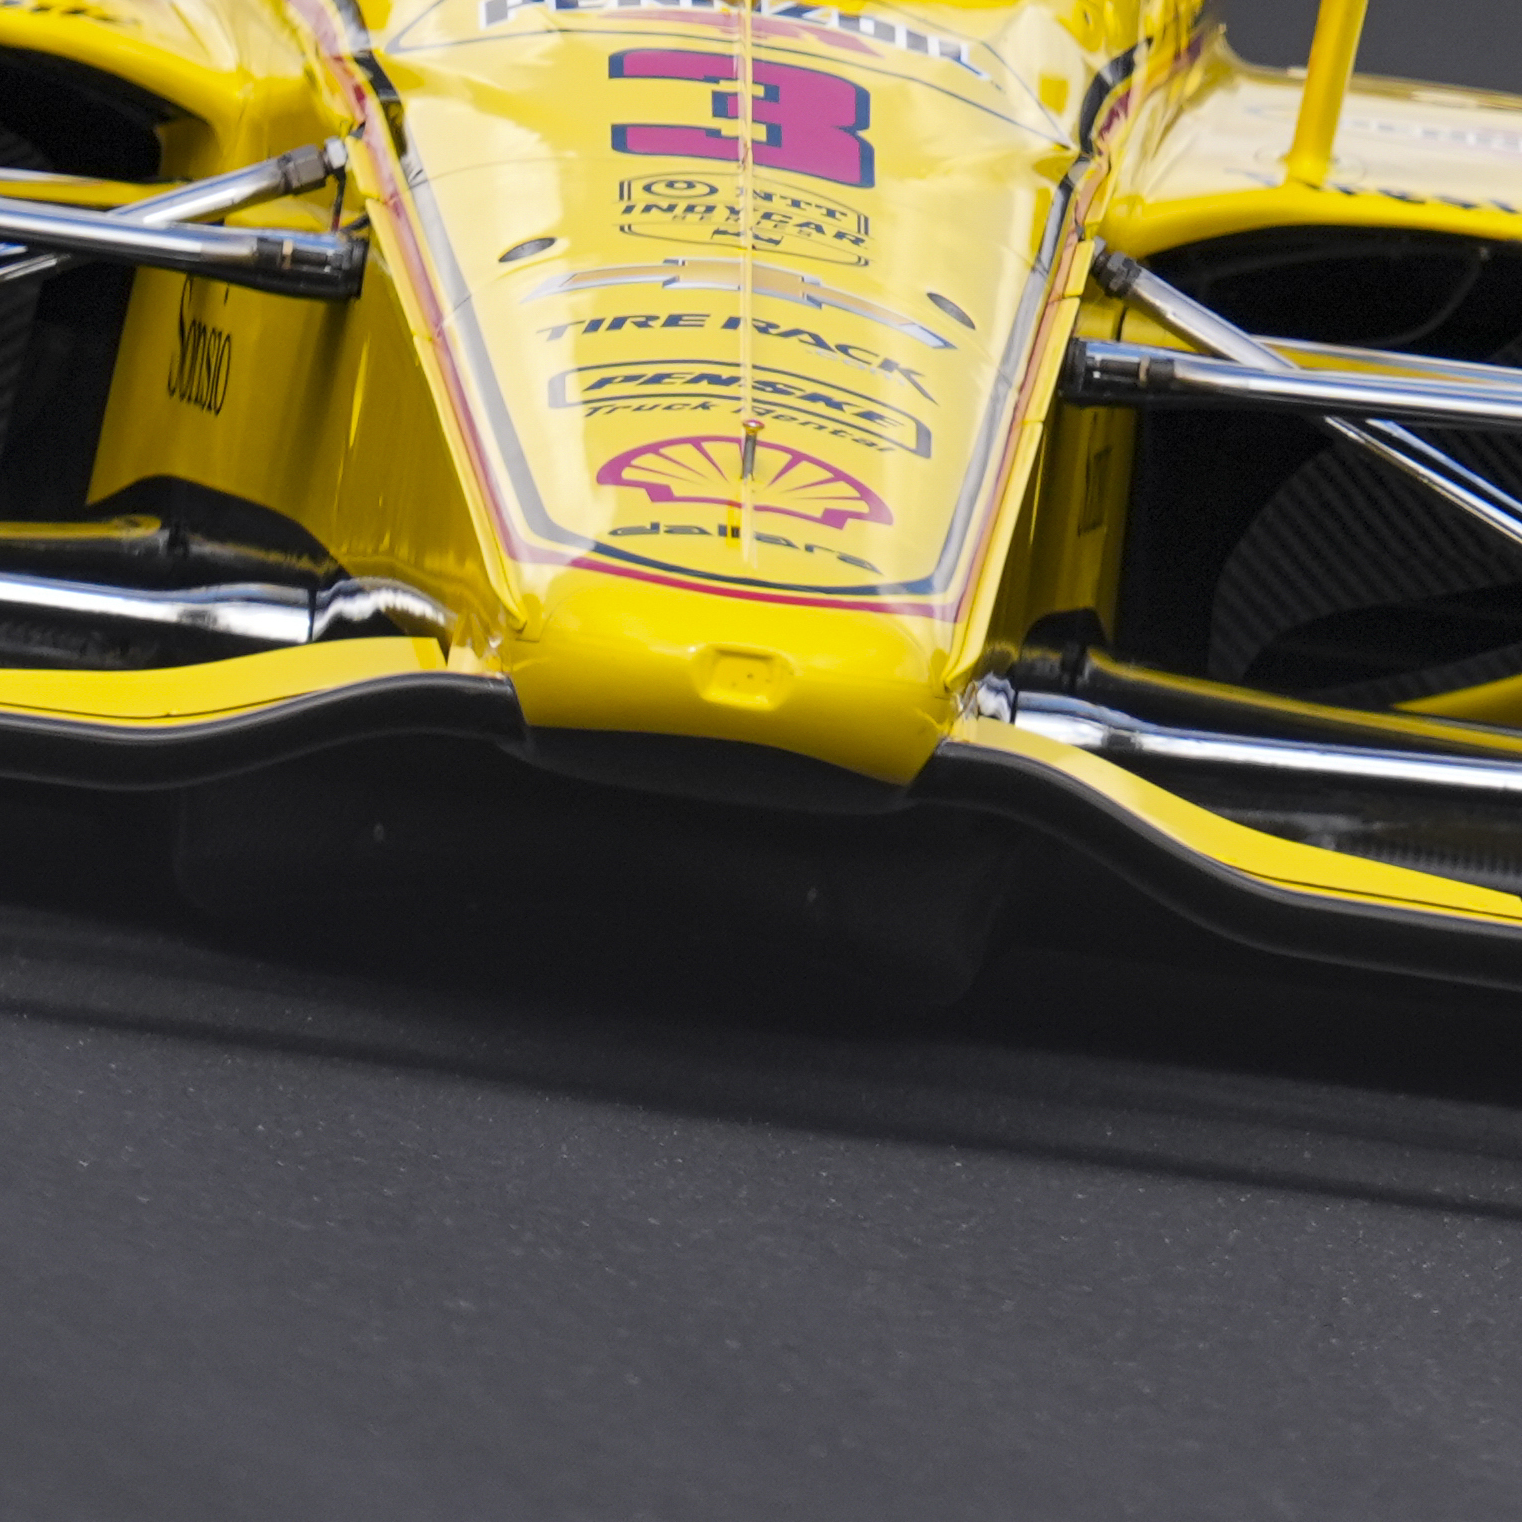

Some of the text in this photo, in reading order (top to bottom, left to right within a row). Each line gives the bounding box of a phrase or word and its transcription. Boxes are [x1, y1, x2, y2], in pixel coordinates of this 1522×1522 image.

[608, 48, 875, 188] 3
[620, 202, 870, 251] INDYCAR
[734, 186, 848, 222] NTT
[535, 313, 940, 407] TIRE RACK
[581, 371, 910, 430] PENSKE
[582, 400, 898, 453] Truck Rental
[607, 521, 885, 576] dallara
